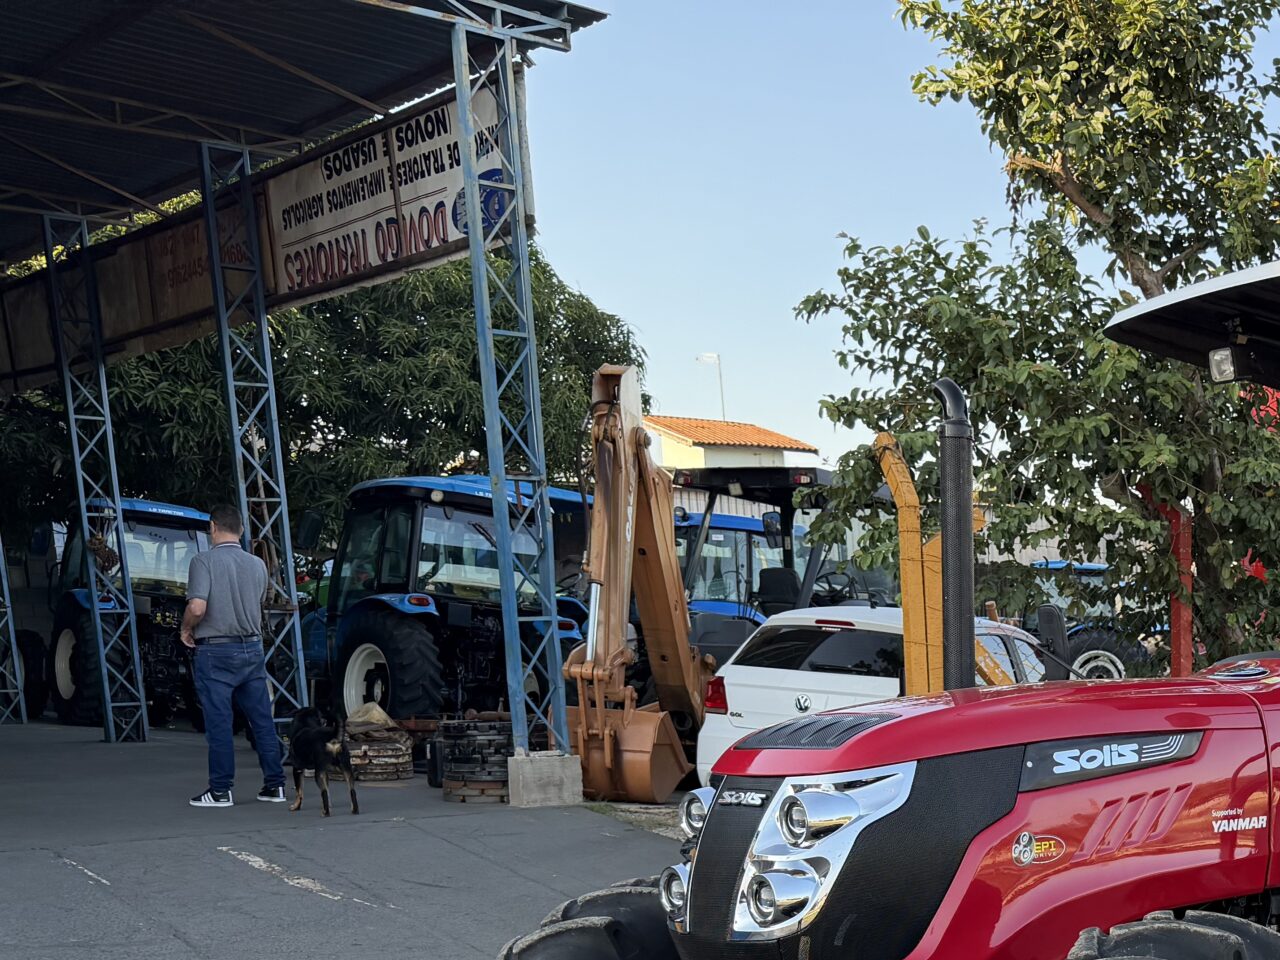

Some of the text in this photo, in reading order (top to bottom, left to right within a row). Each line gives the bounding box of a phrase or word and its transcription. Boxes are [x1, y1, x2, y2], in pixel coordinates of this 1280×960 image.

[396, 145, 447, 187] TRATORES
[449, 140, 462, 170] DE
[327, 167, 386, 210] IMPLEMENTOS
[284, 228, 373, 291] TRATORES
[1211, 807, 1244, 818] Supported by
[1211, 815, 1268, 833] YANMAR
[1034, 840, 1057, 853] EPI
[1034, 851, 1058, 859] DRIVE
